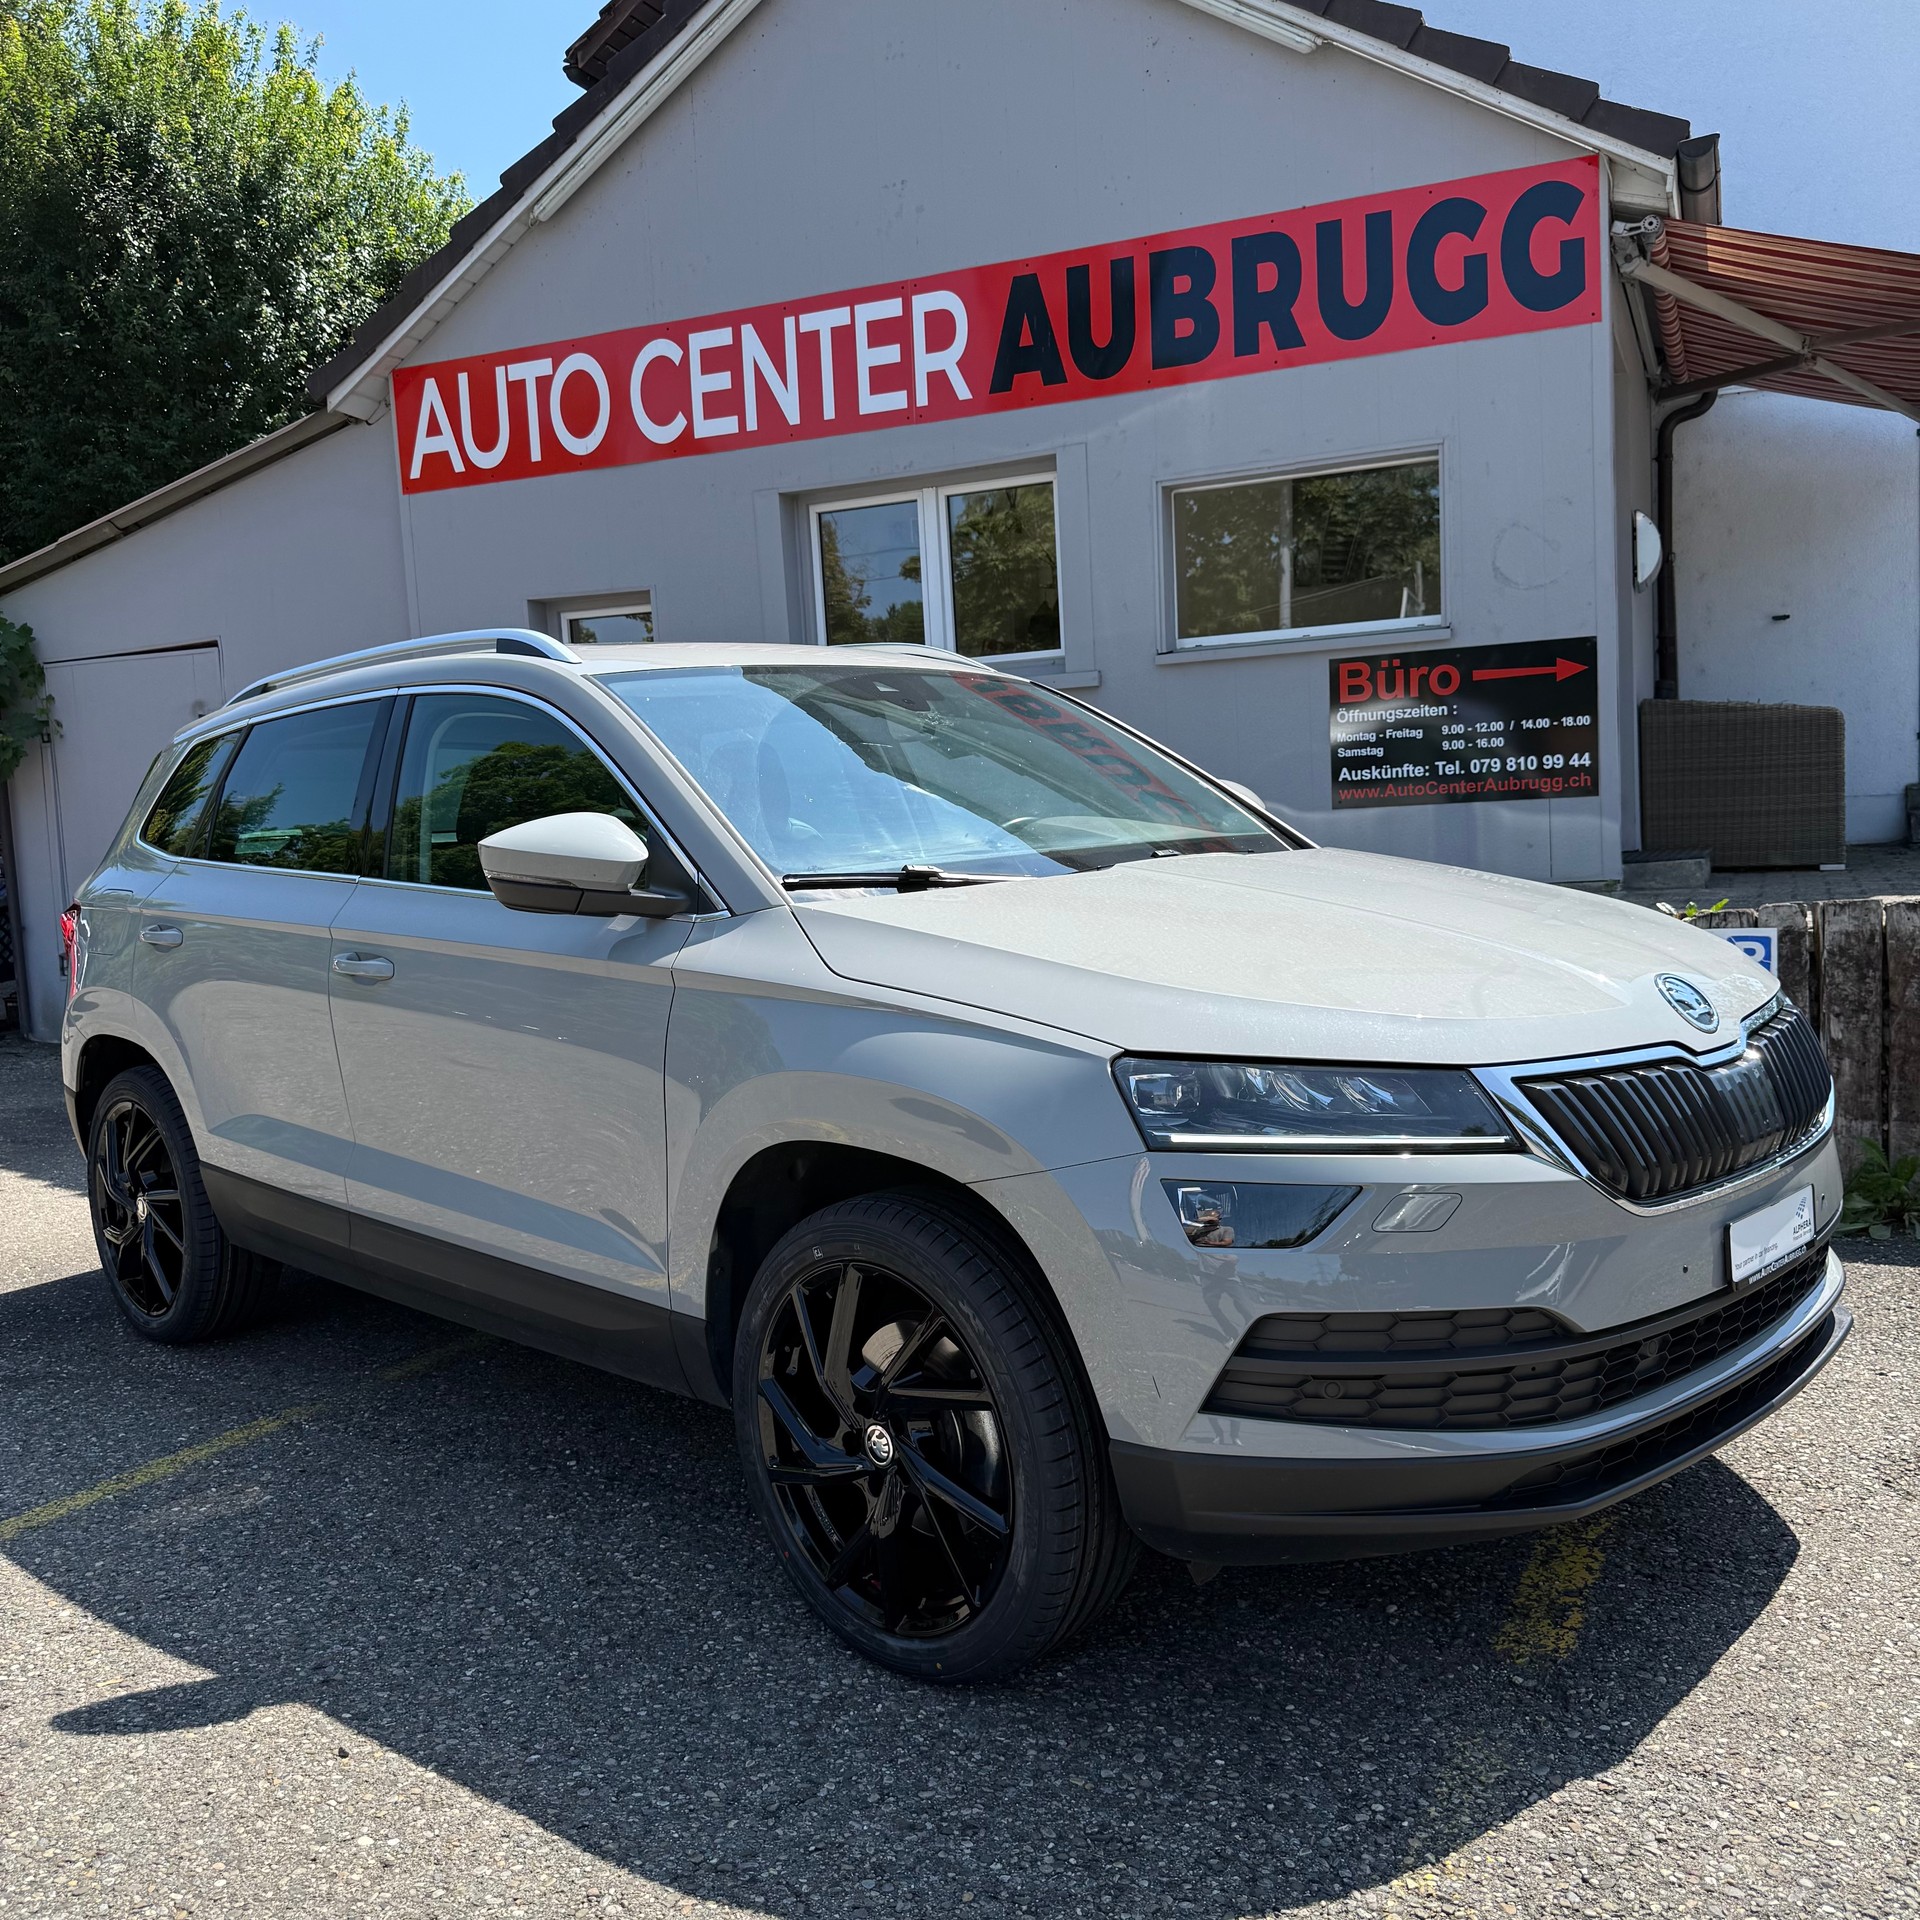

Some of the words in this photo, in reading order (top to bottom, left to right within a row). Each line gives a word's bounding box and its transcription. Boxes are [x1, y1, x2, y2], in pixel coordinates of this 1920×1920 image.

[408, 352, 611, 480] AUTO
[629, 290, 974, 445] CENTER
[988, 179, 1587, 395] AUBRUGG
[1338, 659, 1461, 704] Büro
[1336, 705, 1448, 723] Öffnungszeiten
[1337, 732, 1376, 742] Montag
[1386, 728, 1424, 739] Freitag
[1441, 724, 1465, 735] 9.00
[1475, 721, 1504, 733] 12.00
[1521, 718, 1550, 730] 14.00
[1561, 715, 1591, 727] 18.00
[1337, 747, 1384, 757] Samstag
[1442, 739, 1465, 751] 9.00
[1475, 737, 1504, 749] 16.00
[1338, 763, 1430, 781] Auskünfte:
[1435, 760, 1466, 776] Tel.
[1470, 758, 1501, 774] 079
[1506, 755, 1537, 771] 810
[1542, 754, 1564, 769] 99
[1569, 752, 1592, 767] 44
[1339, 772, 1592, 799] www.AutoCenterAubrugg.ch
